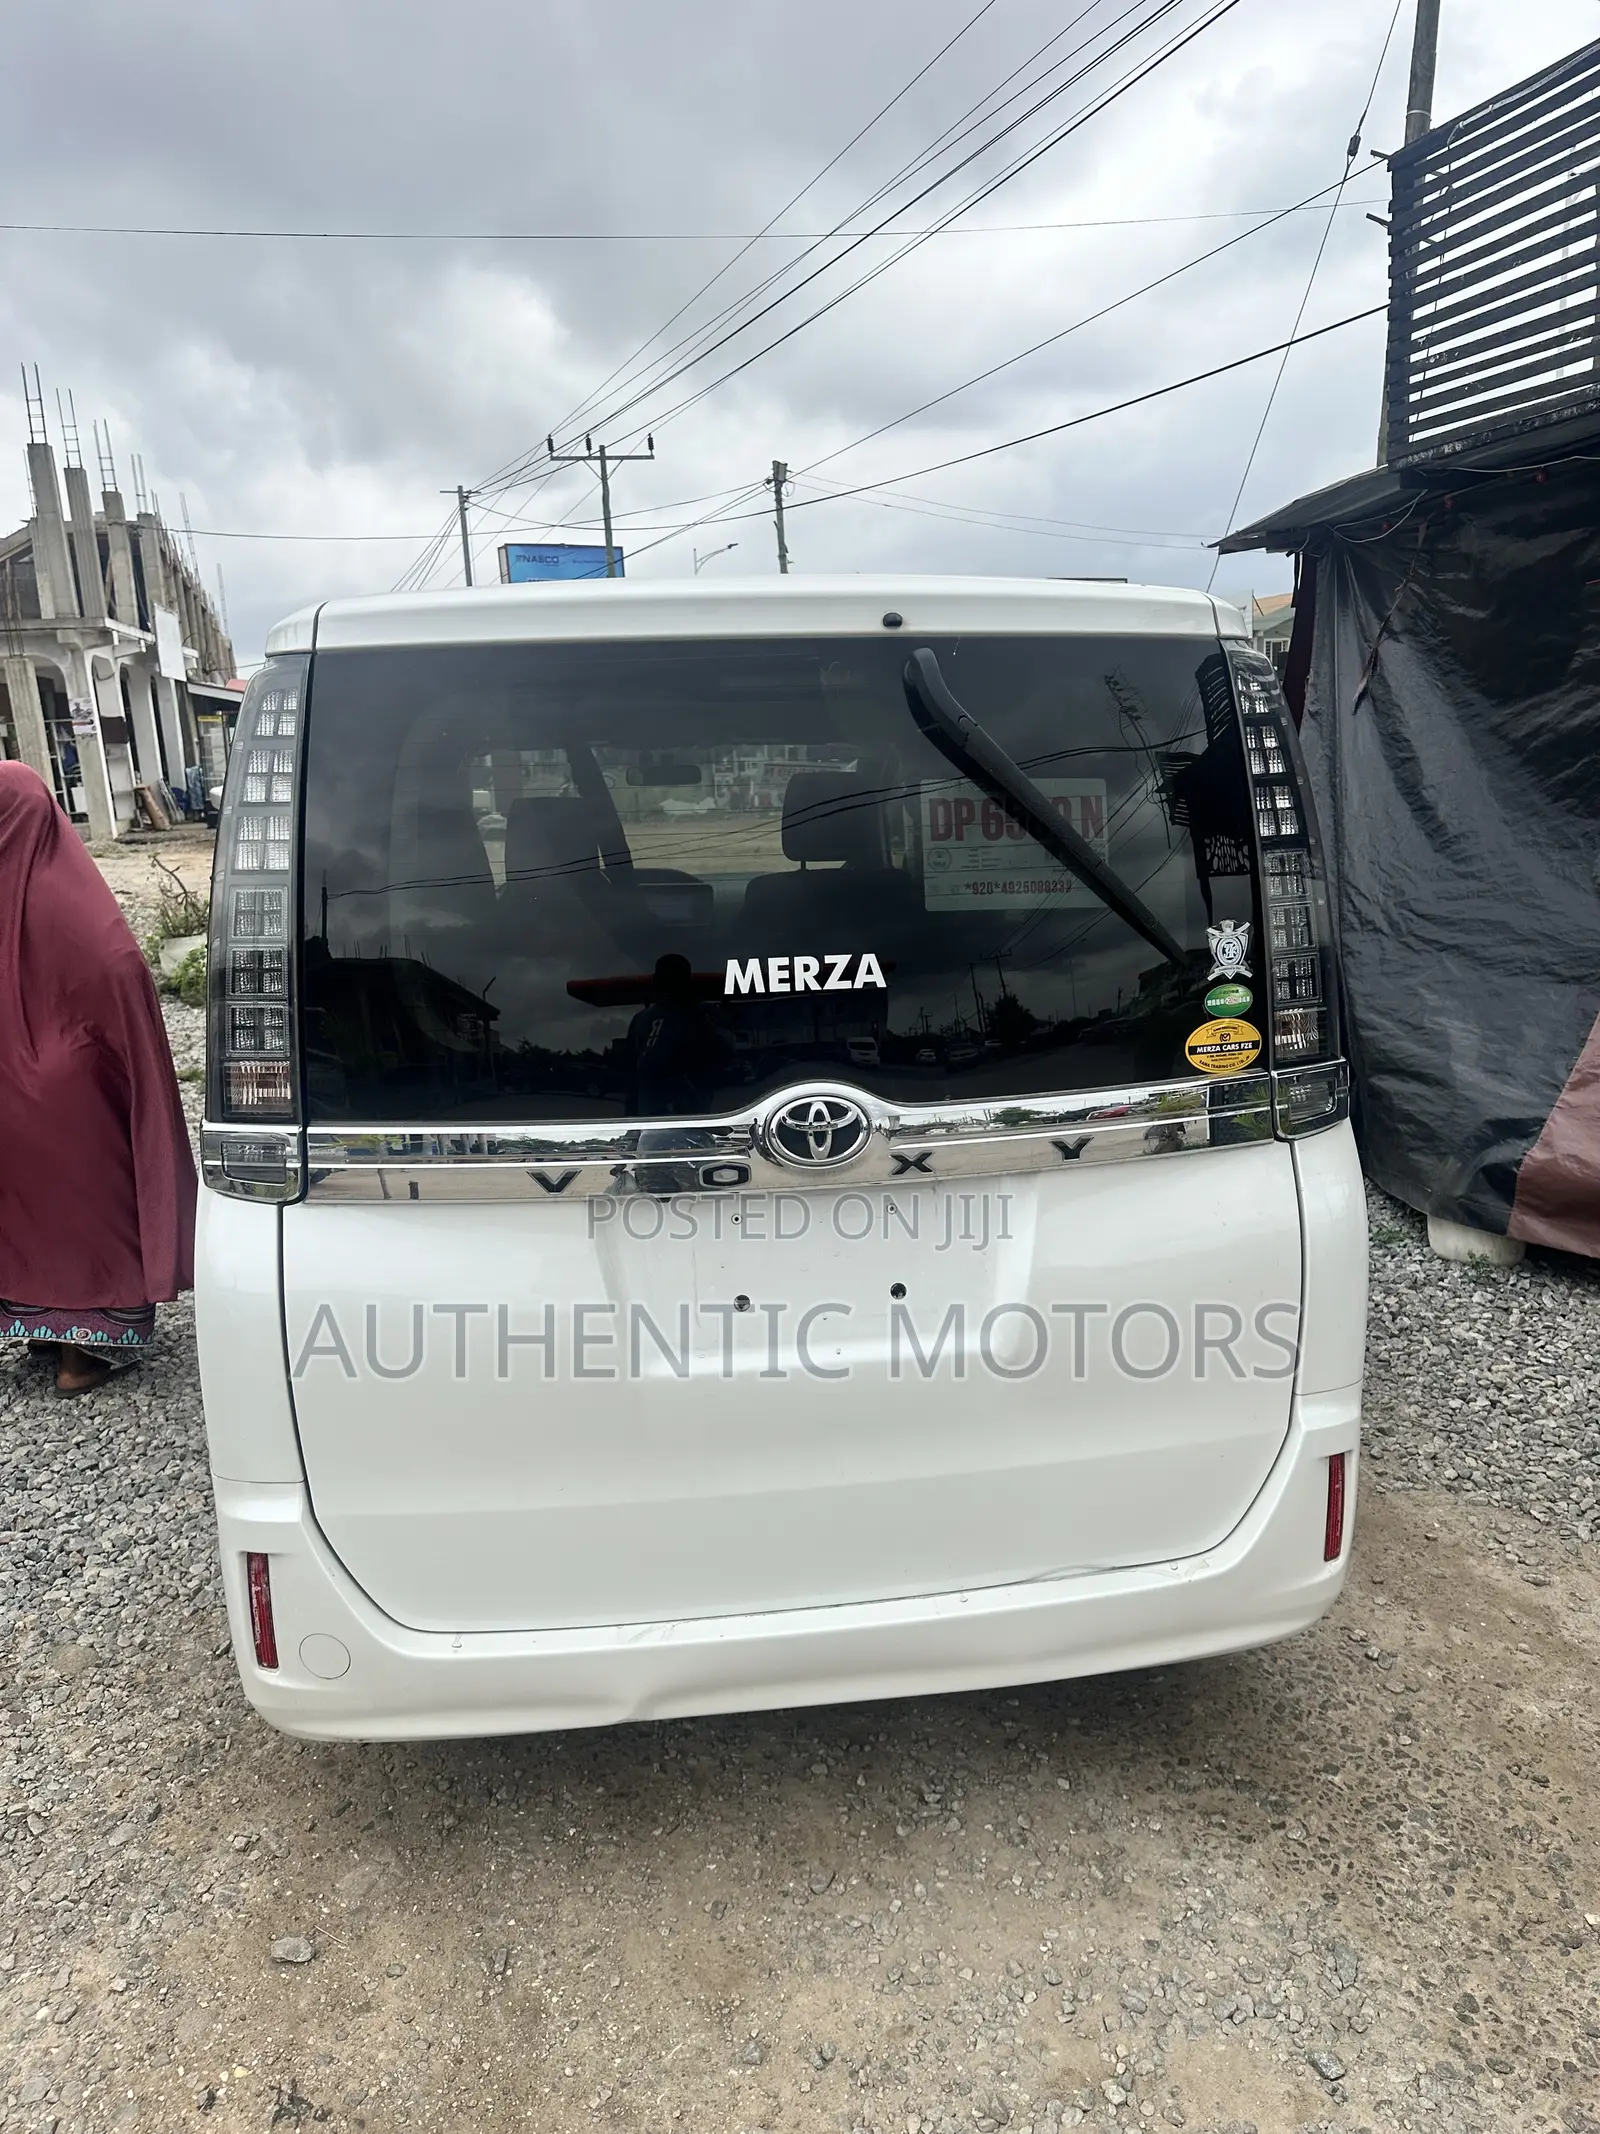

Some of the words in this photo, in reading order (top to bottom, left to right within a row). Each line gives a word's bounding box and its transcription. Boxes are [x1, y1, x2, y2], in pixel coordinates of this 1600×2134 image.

[724, 953, 887, 995] MERZA
[1196, 1046, 1221, 1054] MERZA
[1240, 1042, 1253, 1050] FZE
[525, 1136, 1095, 1194] VOXY
